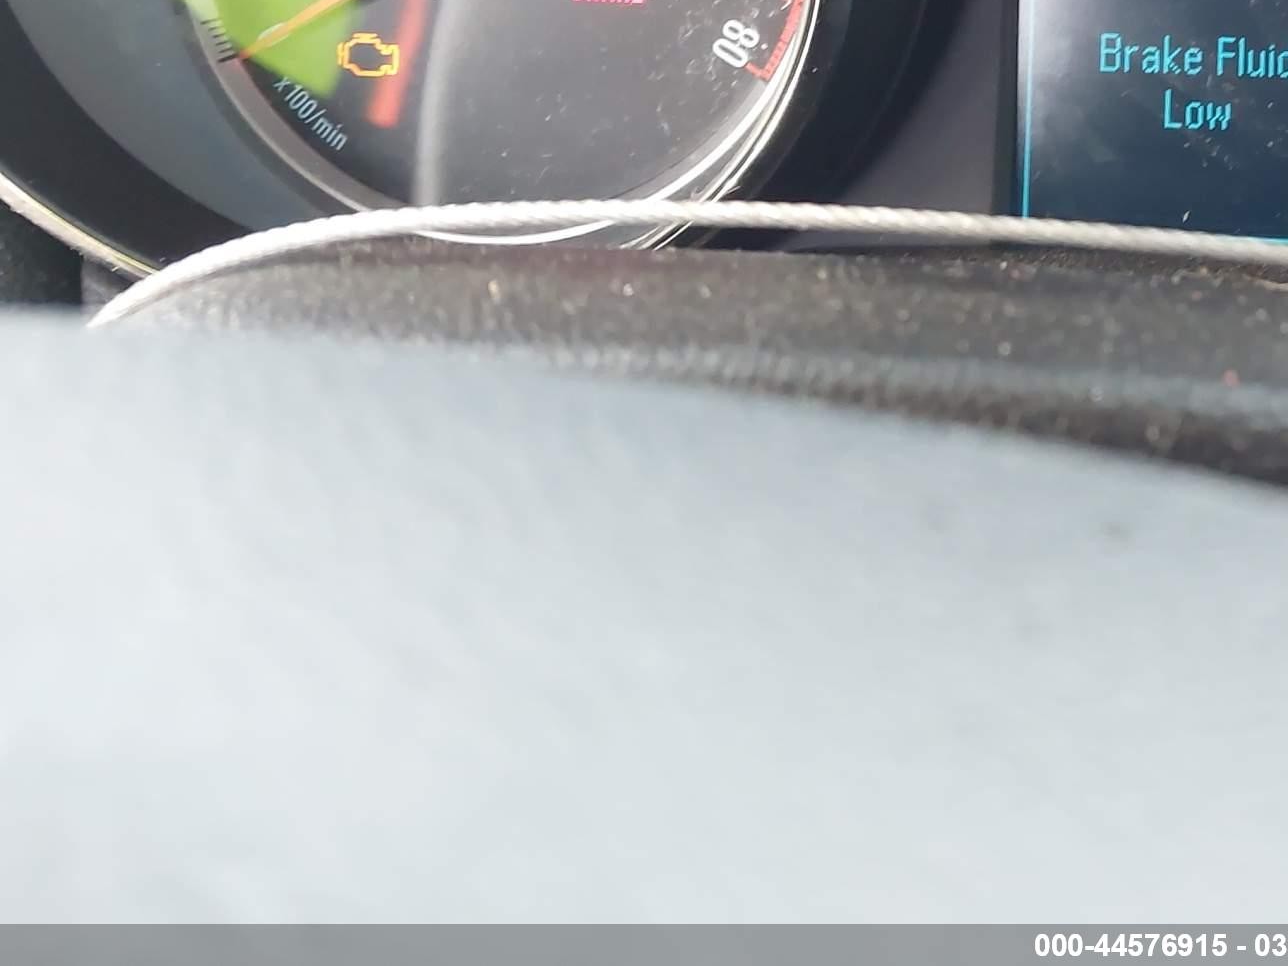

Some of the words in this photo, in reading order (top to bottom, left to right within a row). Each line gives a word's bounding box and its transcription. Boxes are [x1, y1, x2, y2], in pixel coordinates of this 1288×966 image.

[712, 19, 760, 68] 80
[1099, 33, 1203, 74] Brake
[1163, 90, 1231, 130] Low
